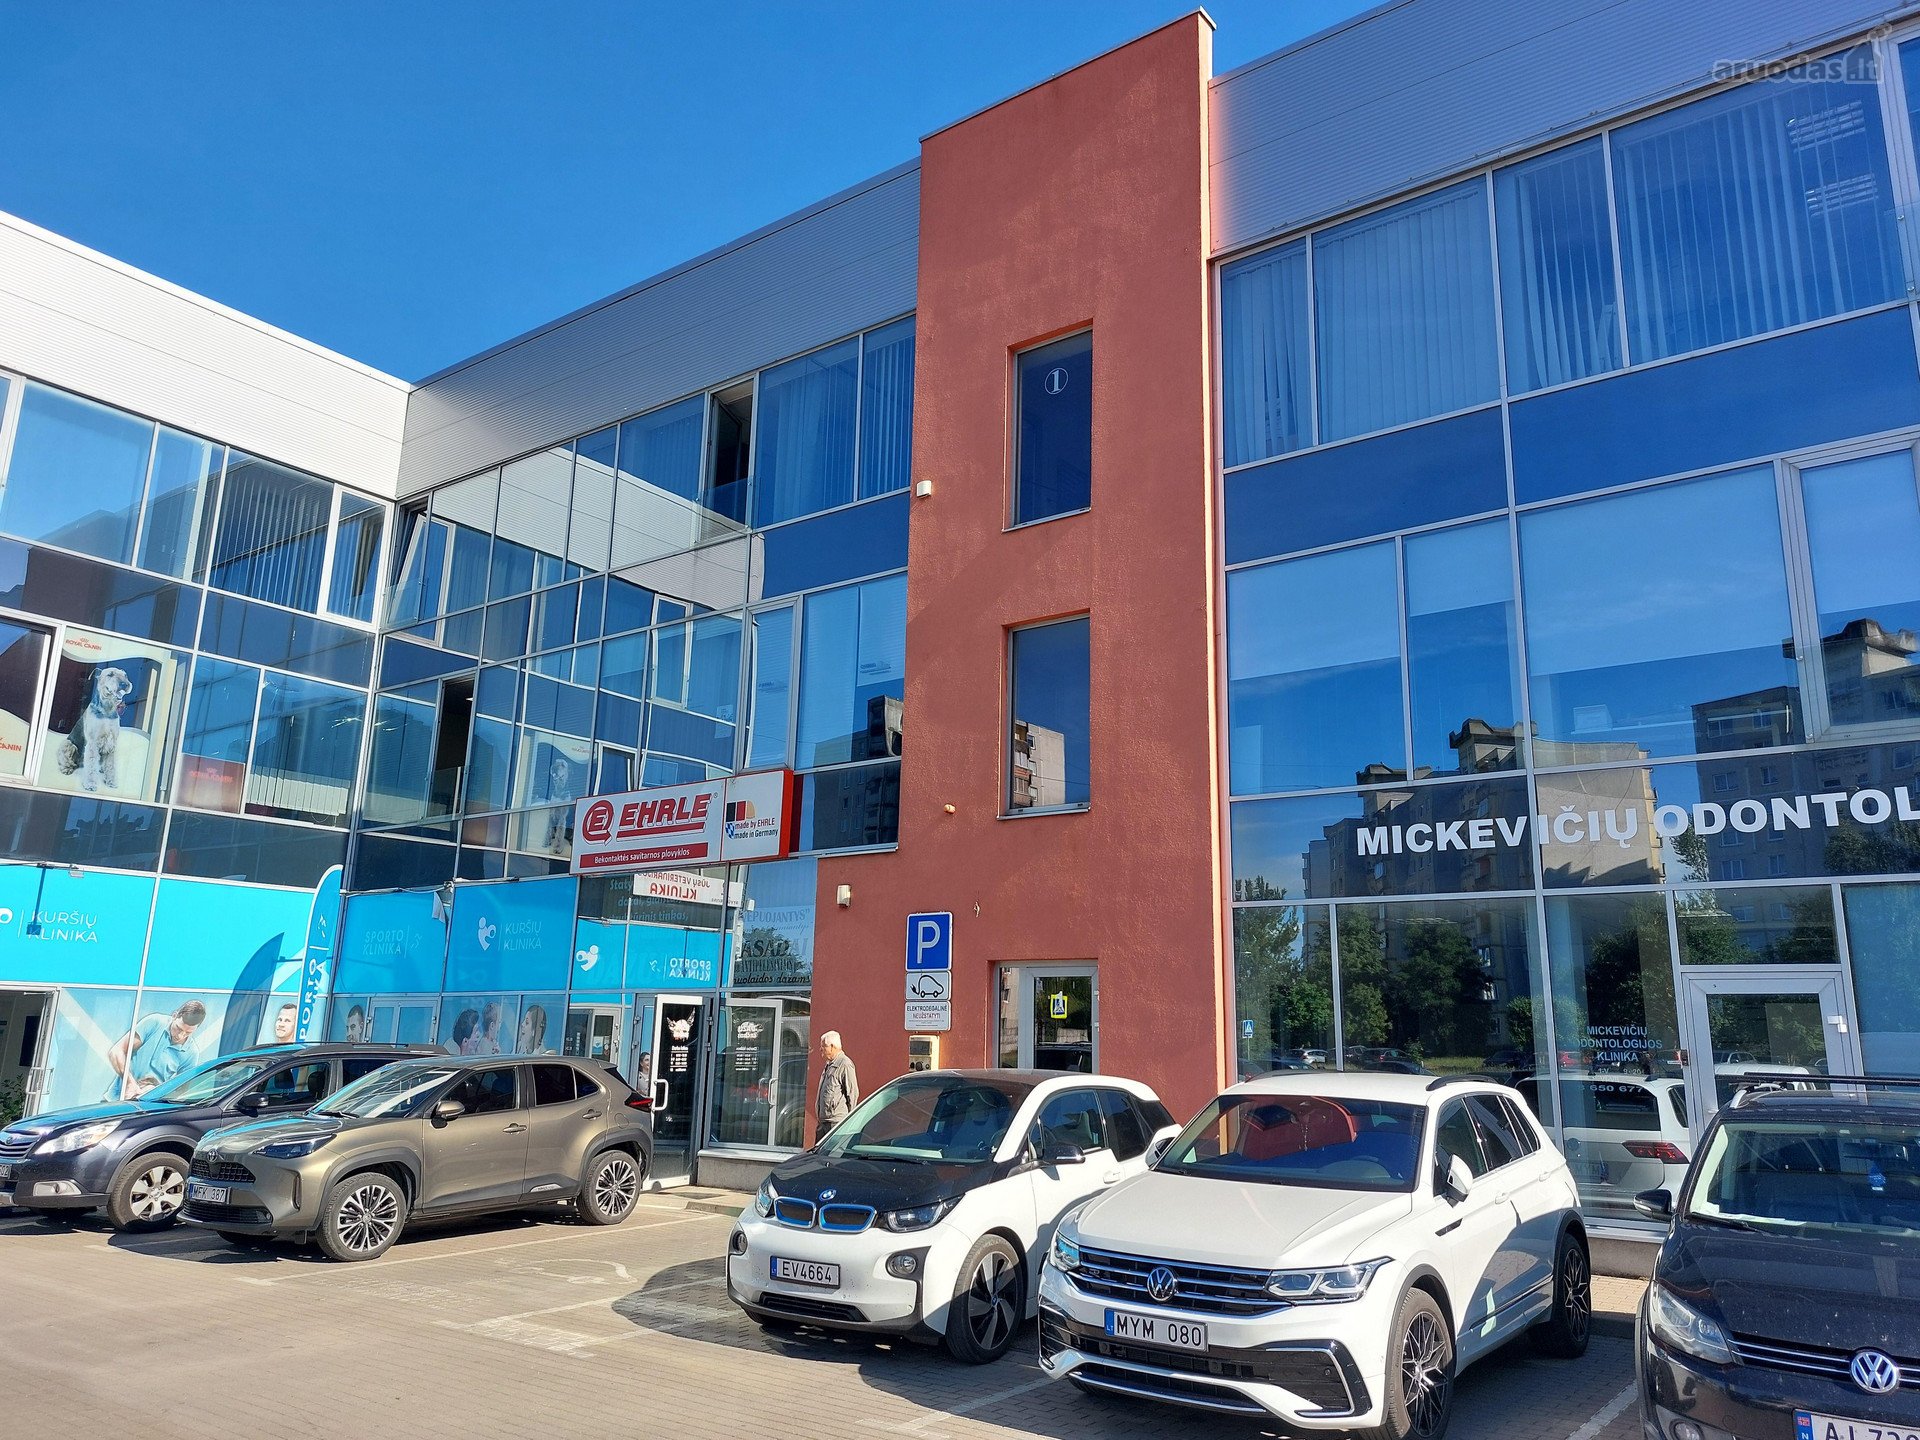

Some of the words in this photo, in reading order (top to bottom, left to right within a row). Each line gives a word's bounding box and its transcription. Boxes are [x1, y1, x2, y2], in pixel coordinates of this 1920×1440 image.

[618, 793, 712, 829] EHRLE
[735, 821, 749, 829] made
[750, 820, 758, 829] by
[758, 817, 776, 827] EHRLE
[1356, 804, 1638, 856] MICKEVIČIŲ
[1653, 786, 1920, 838] ODONTOL
[734, 831, 748, 839] made
[749, 829, 755, 838] in
[755, 829, 779, 838] Germany
[594, 853, 629, 864] Bekontaktės
[629, 851, 661, 861] savitarnos
[661, 848, 690, 859] plovyklos
[31, 910, 98, 930] KURŠIŲ
[505, 920, 542, 937] KURŠIŲ
[28, 926, 98, 943] KLINIKA
[364, 929, 404, 943] SPORTO
[916, 920, 941, 964] P
[363, 942, 402, 956] KLINIKA
[503, 938, 542, 951] KLINIKA
[299, 958, 317, 1040] PORTO
[1586, 1024, 1648, 1038] MICKEVIČIŲ
[1596, 1051, 1639, 1062] KLINIKA
[782, 1261, 832, 1283] EV4664
[1116, 1314, 1154, 1340] MYM
[1168, 1323, 1202, 1347] 080
